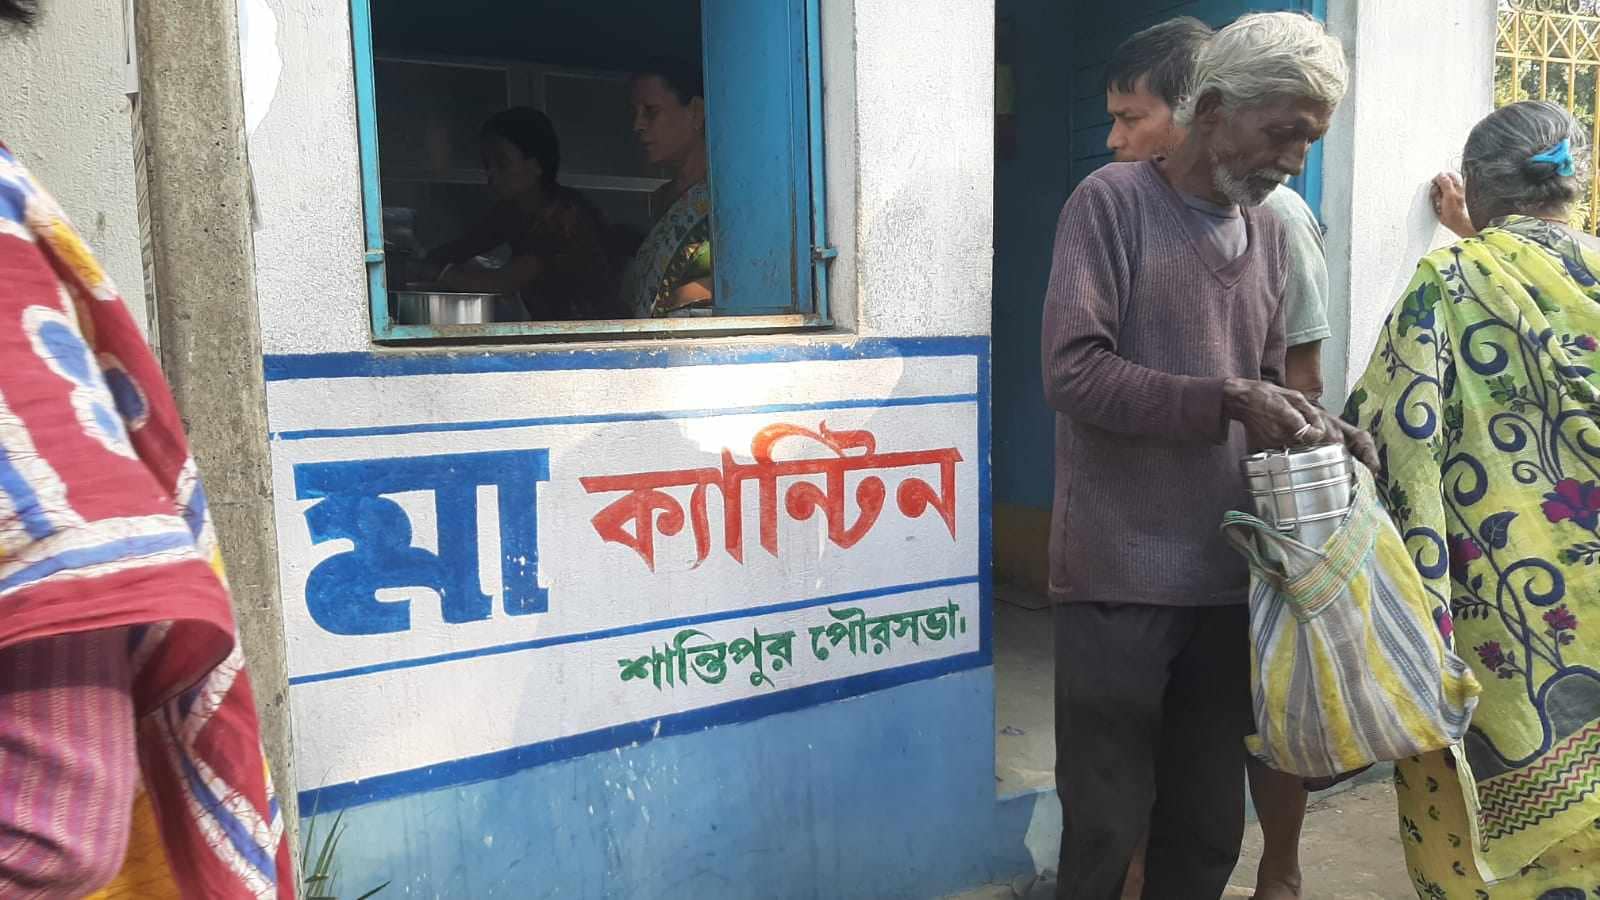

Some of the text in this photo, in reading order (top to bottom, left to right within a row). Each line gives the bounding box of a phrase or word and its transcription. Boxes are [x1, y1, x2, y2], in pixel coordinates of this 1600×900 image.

[293, 420, 963, 636] মা ক্যান্টিন
[617, 628, 796, 690] শান্তিপুর
